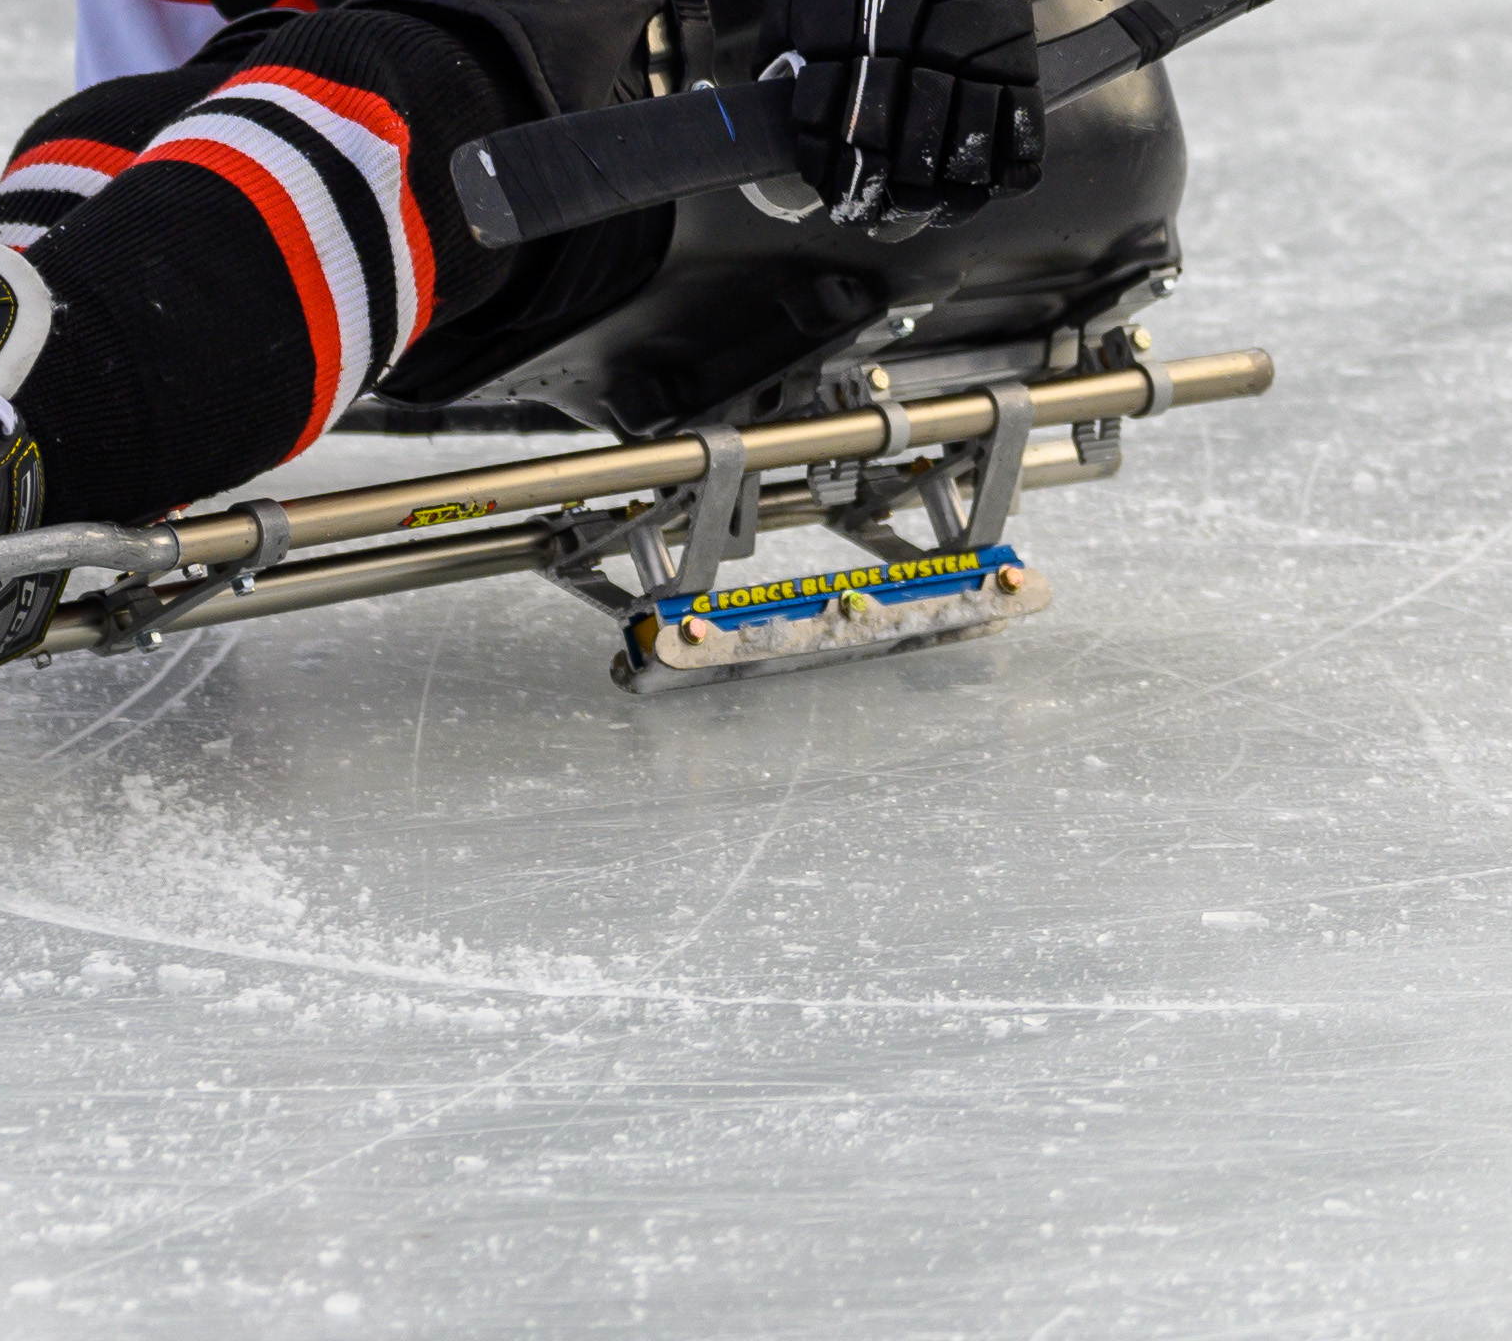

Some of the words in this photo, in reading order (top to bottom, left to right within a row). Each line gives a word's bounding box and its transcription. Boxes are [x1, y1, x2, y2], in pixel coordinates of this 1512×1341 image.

[692, 594, 711, 614] G
[717, 581, 796, 610] FORCE
[801, 567, 882, 597] BLADE
[887, 552, 979, 582] SYSTEM
